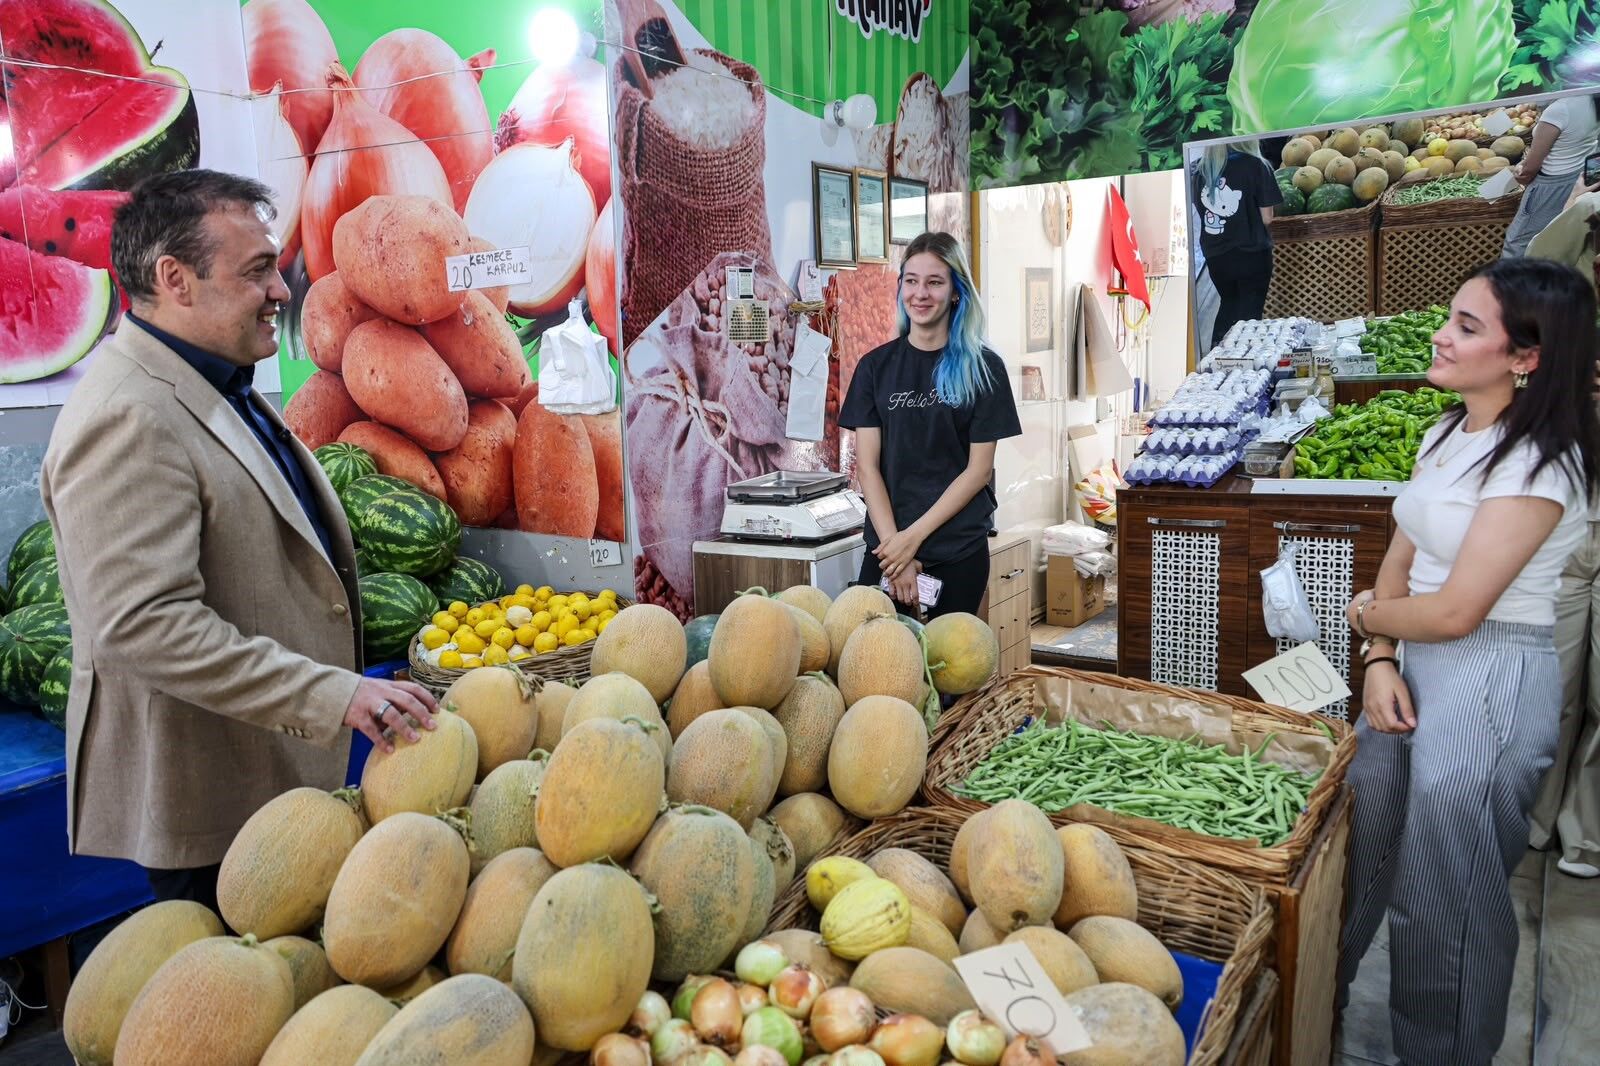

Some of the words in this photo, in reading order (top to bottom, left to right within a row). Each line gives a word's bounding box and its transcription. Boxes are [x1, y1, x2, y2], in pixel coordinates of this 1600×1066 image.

[452, 266, 473, 289] 20
[888, 390, 928, 410] Hello
[590, 549, 609, 565] 120
[1264, 655, 1333, 707] 100
[983, 957, 1057, 1039] 70
